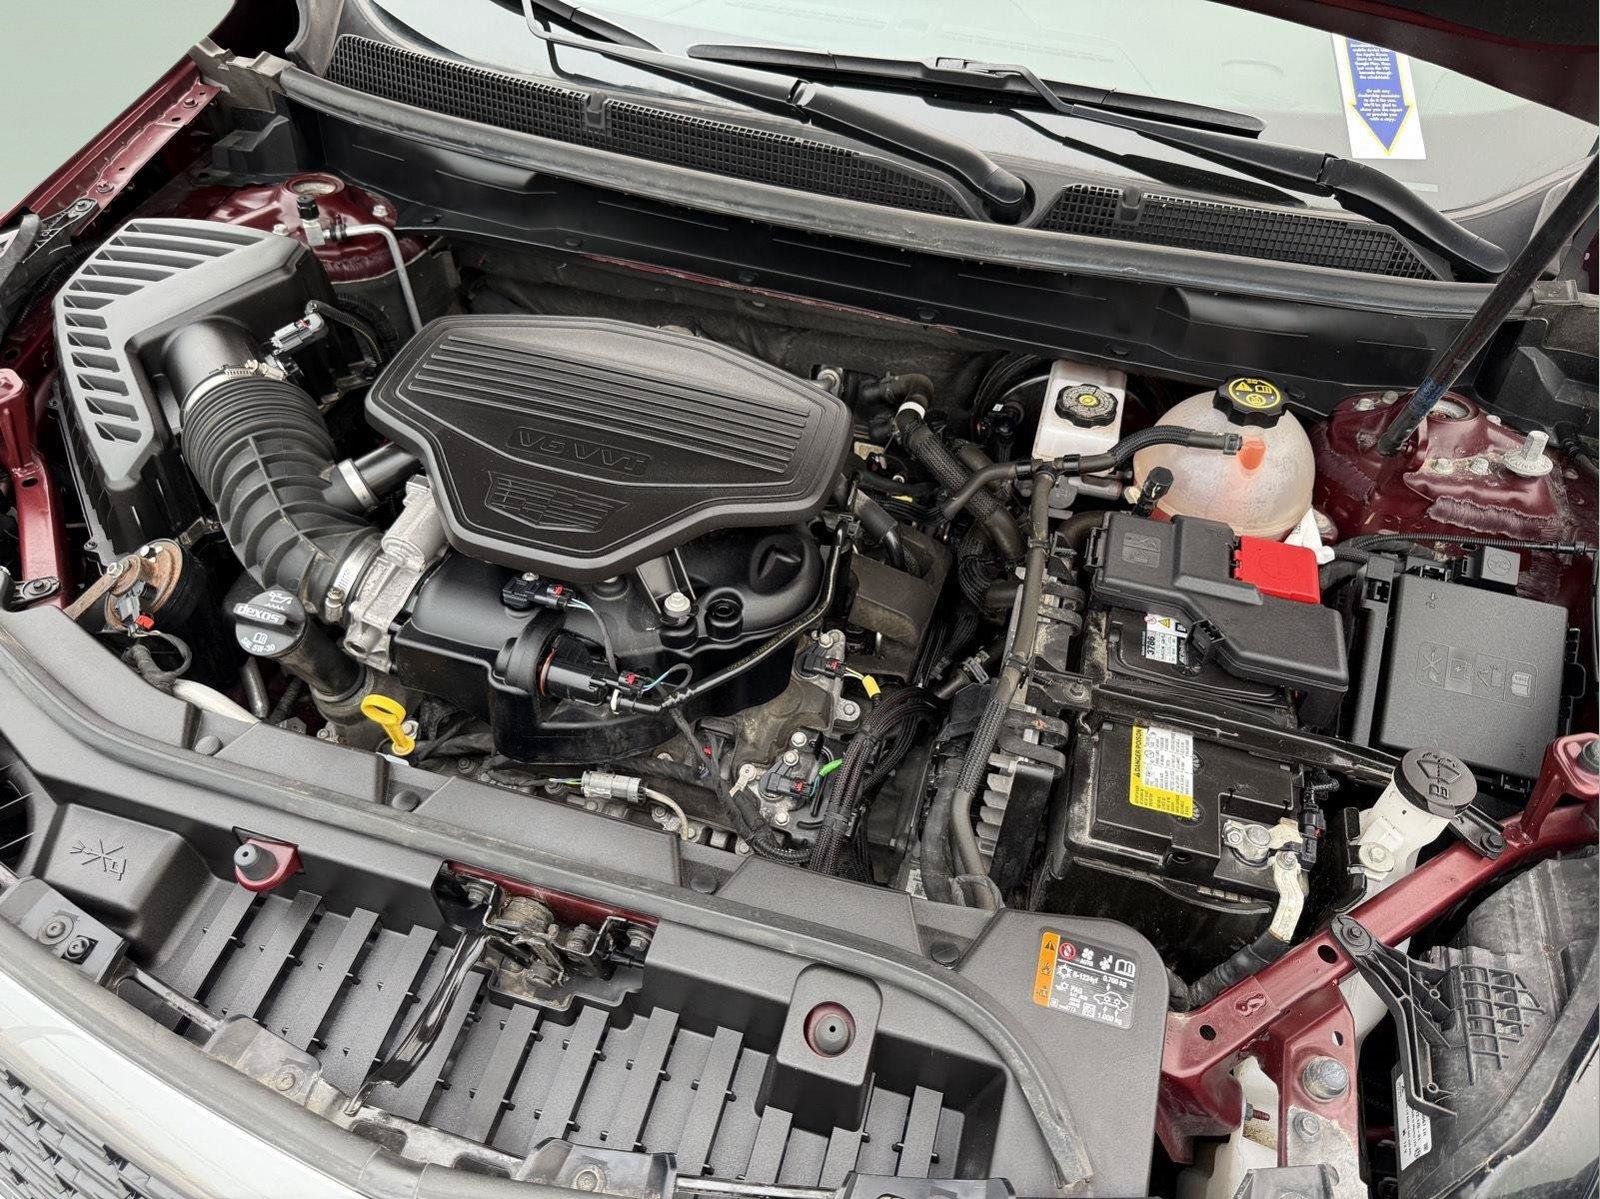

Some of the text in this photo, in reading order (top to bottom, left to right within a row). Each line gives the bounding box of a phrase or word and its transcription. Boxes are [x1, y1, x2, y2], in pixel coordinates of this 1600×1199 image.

[237, 604, 281, 623] dexos
[240, 637, 276, 653] SAE 5W-30
[1134, 728, 1143, 772] DANGER POISON
[1070, 986, 1082, 994] PAG
[1119, 979, 1127, 989] kg
[1115, 1016, 1123, 1026] kg
